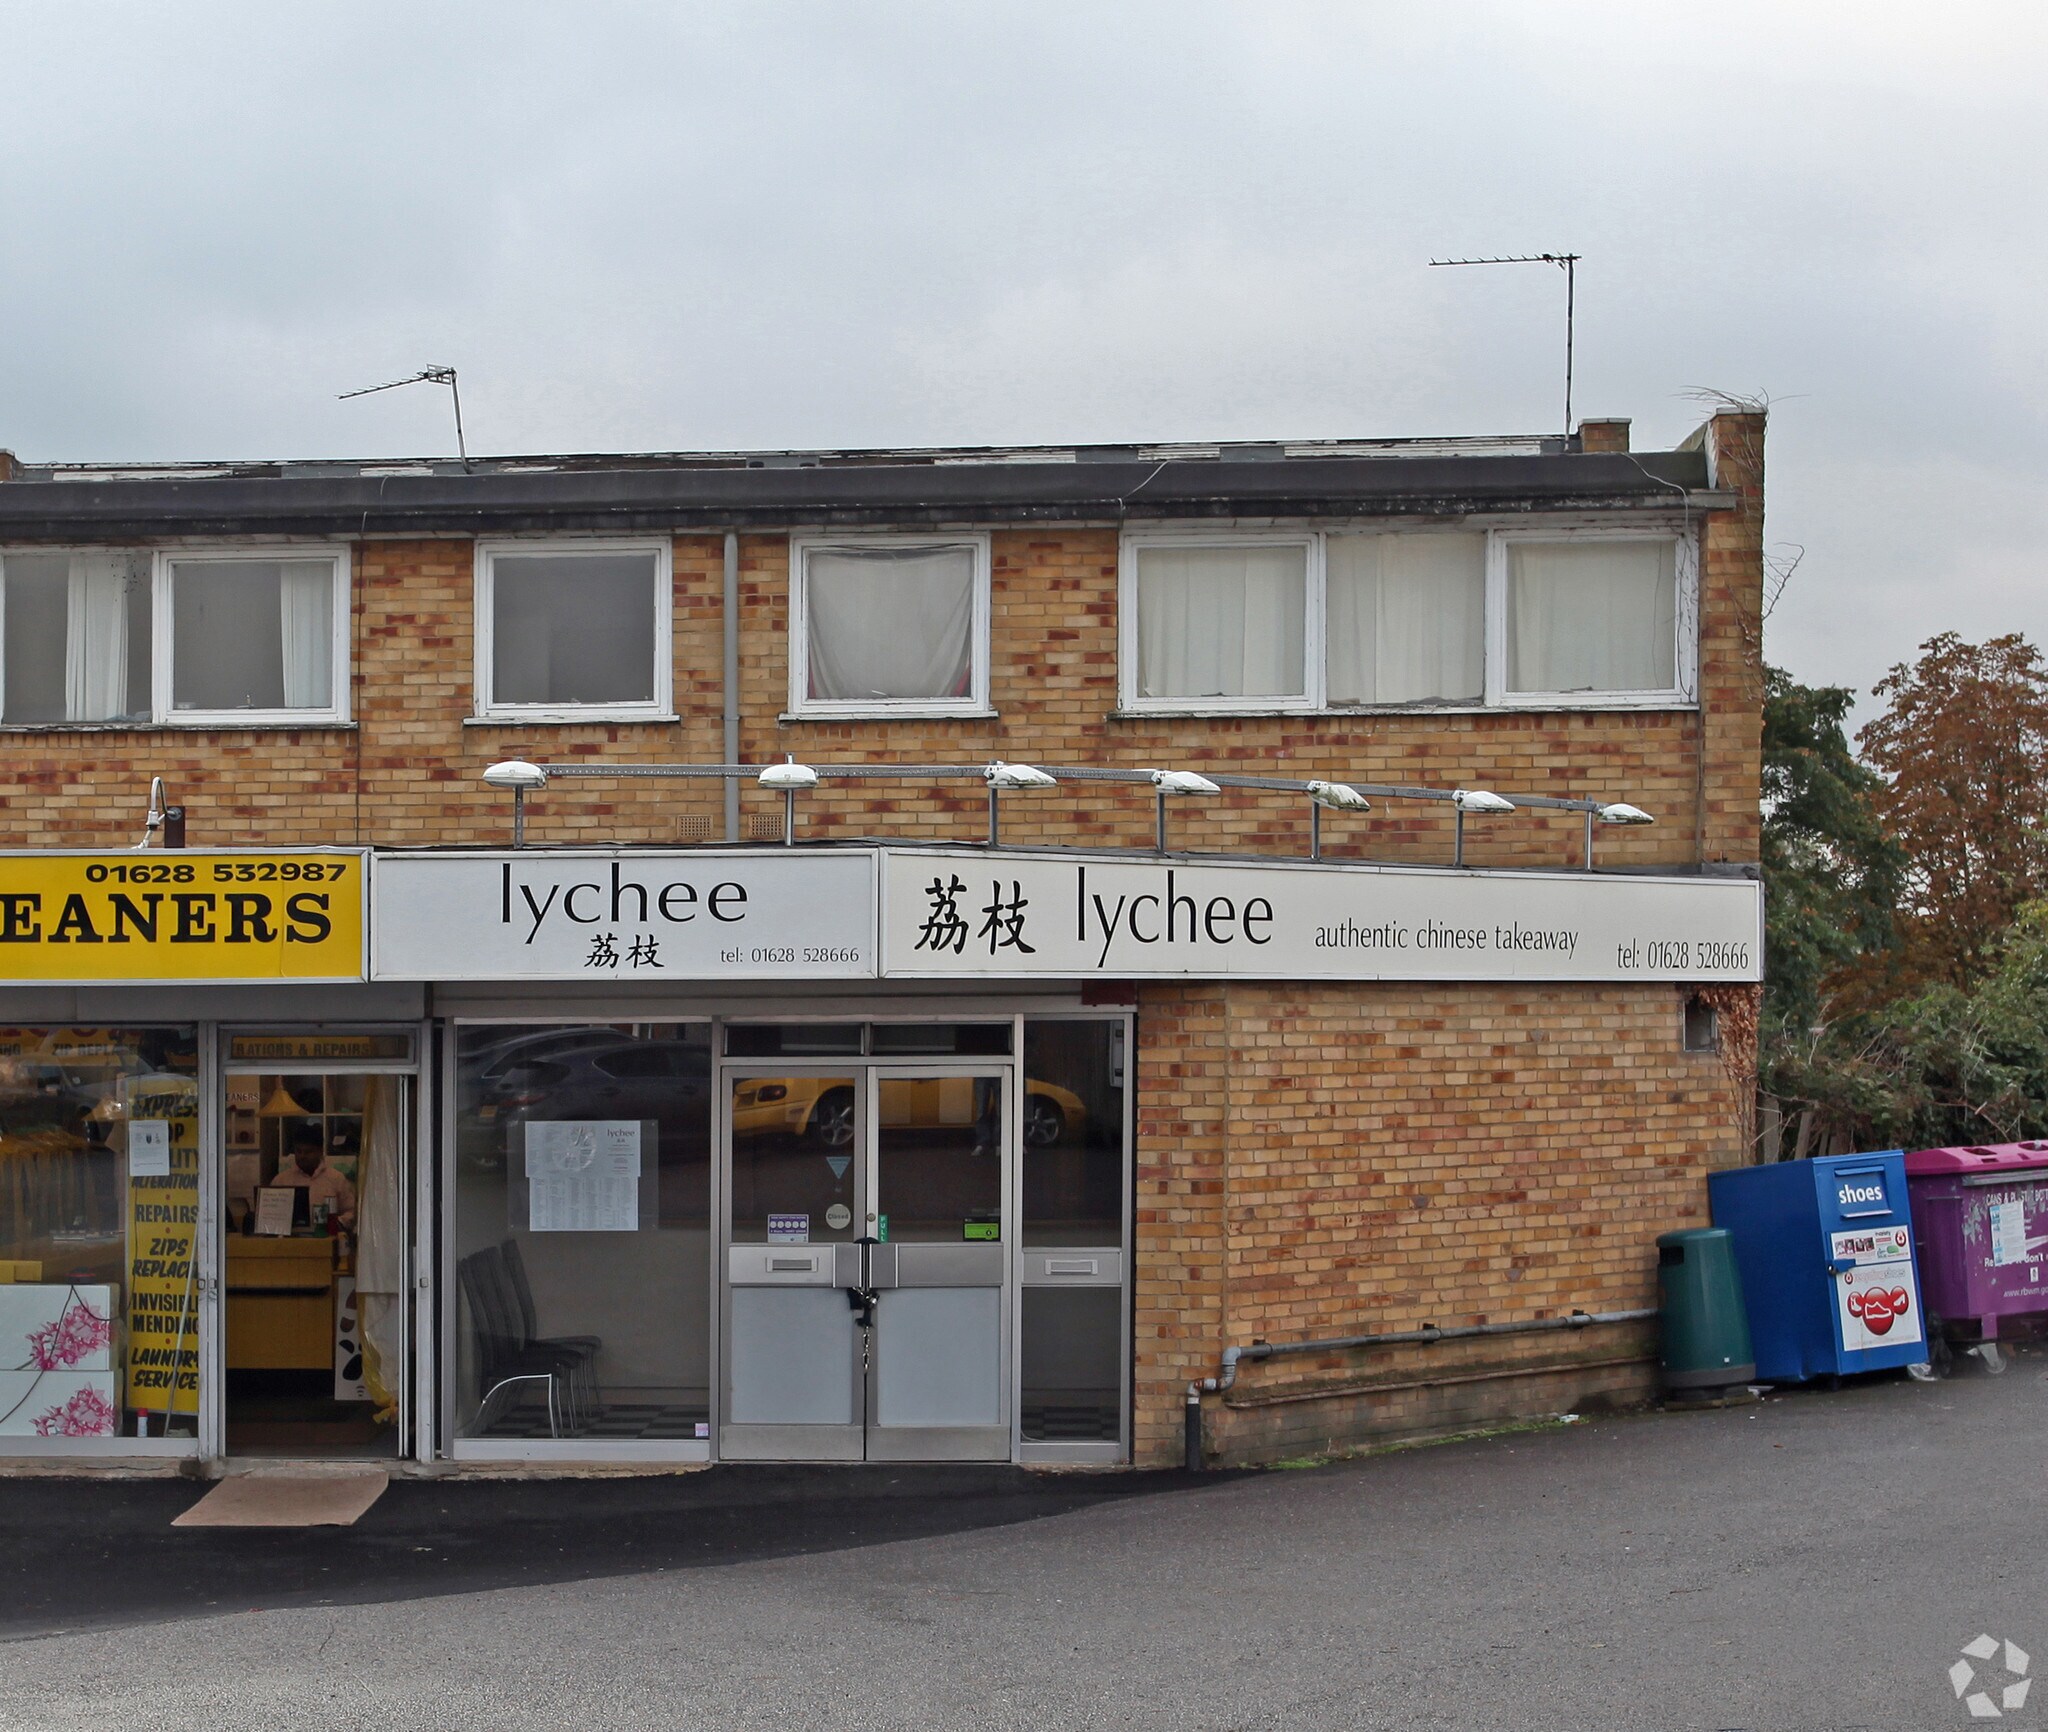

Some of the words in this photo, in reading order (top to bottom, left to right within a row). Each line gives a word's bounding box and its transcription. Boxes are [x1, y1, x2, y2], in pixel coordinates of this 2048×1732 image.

[86, 864, 195, 883] 01628
[213, 863, 347, 882] 532987
[501, 862, 749, 944] lychee
[914, 873, 1036, 955] 荔枝
[0, 892, 332, 944] EANERS
[1077, 866, 1273, 968] lychee
[584, 932, 665, 969] 荔枝
[1314, 917, 1408, 949] authentic
[1416, 919, 1487, 950] chinese
[1494, 921, 1579, 960] takeaway
[720, 948, 743, 963] tel:
[751, 948, 795, 963] 01628
[802, 948, 859, 963] 528666
[1617, 938, 1640, 969] tel:
[1647, 940, 1689, 969] 01628
[1696, 942, 1749, 970] 528666
[607, 1128, 635, 1138] lychee
[1839, 1183, 1883, 1205] shoes
[136, 1204, 199, 1223] REPAIRS
[149, 1238, 189, 1256] ZIPS
[134, 1369, 198, 1390] SERVICE
